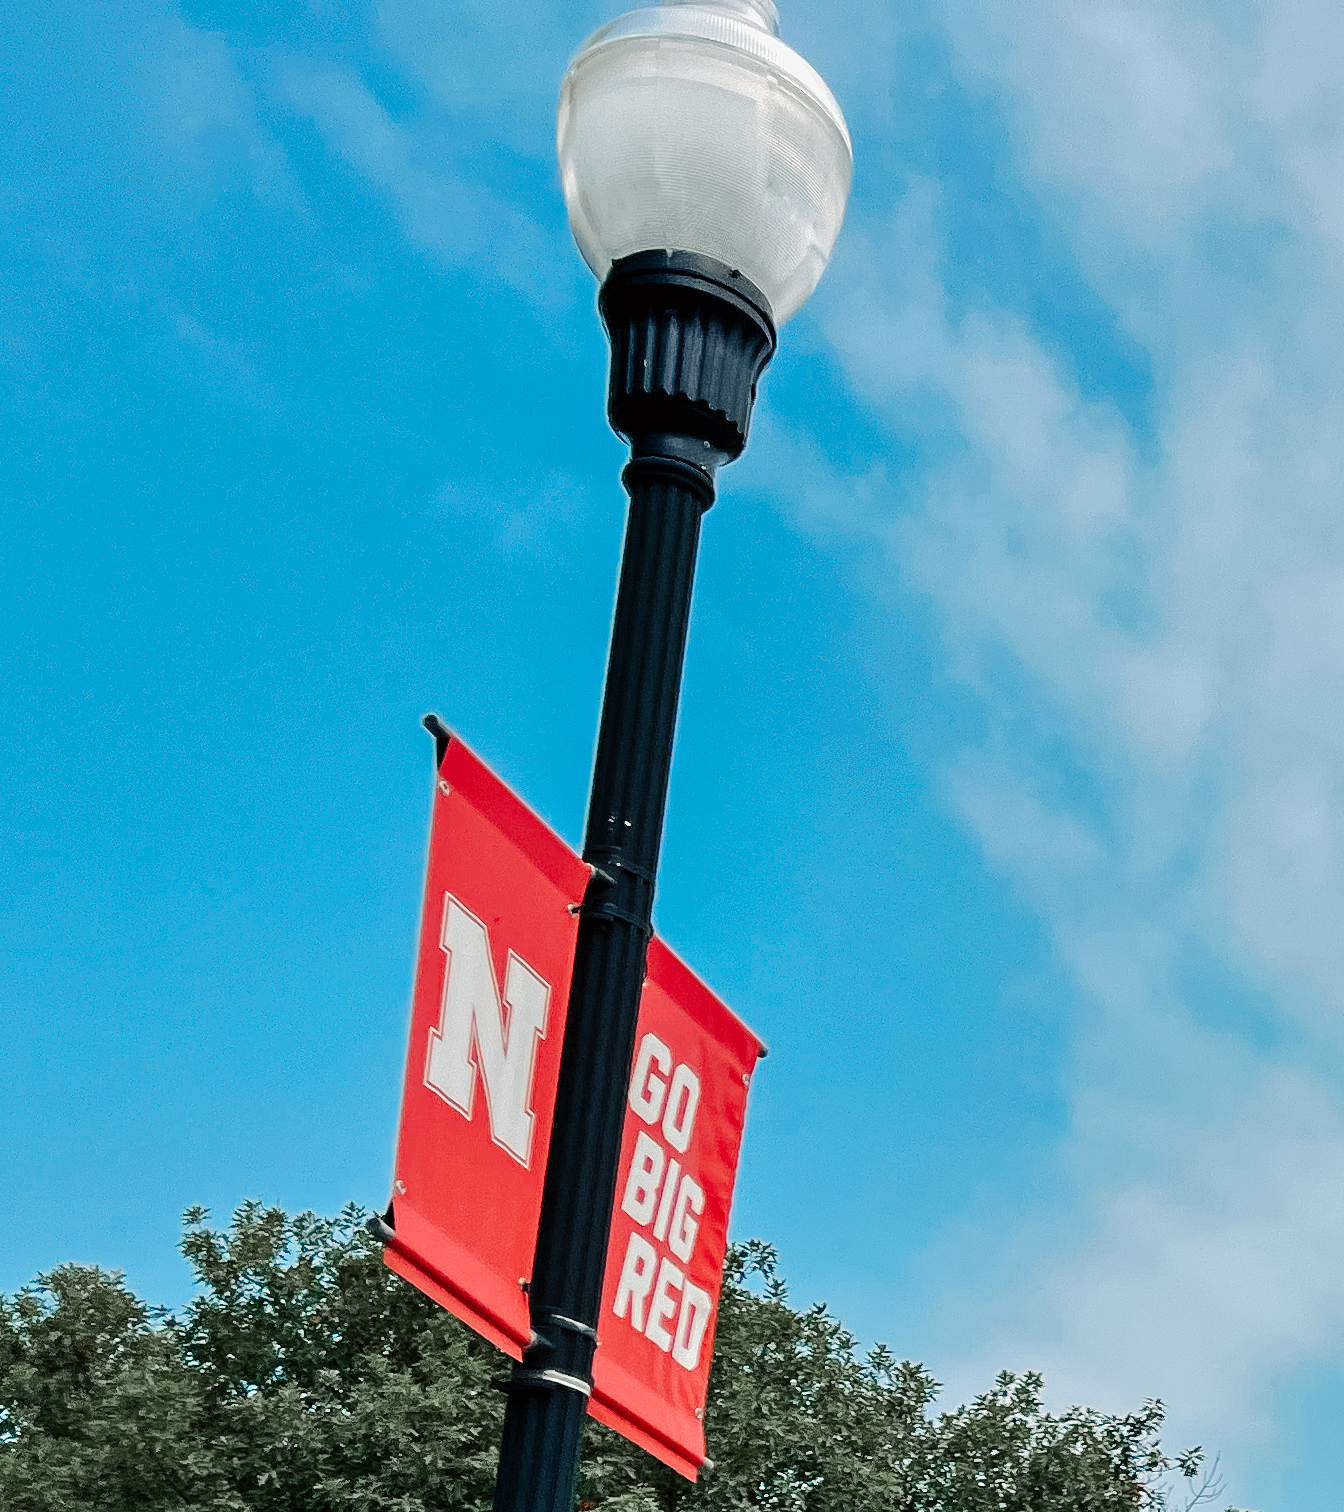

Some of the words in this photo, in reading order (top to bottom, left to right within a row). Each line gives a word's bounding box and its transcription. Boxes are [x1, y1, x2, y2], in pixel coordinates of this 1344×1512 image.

[423, 890, 551, 1170] N
[628, 1031, 700, 1154] GO
[621, 1139, 705, 1264] BIG
[612, 1230, 713, 1372] RED
